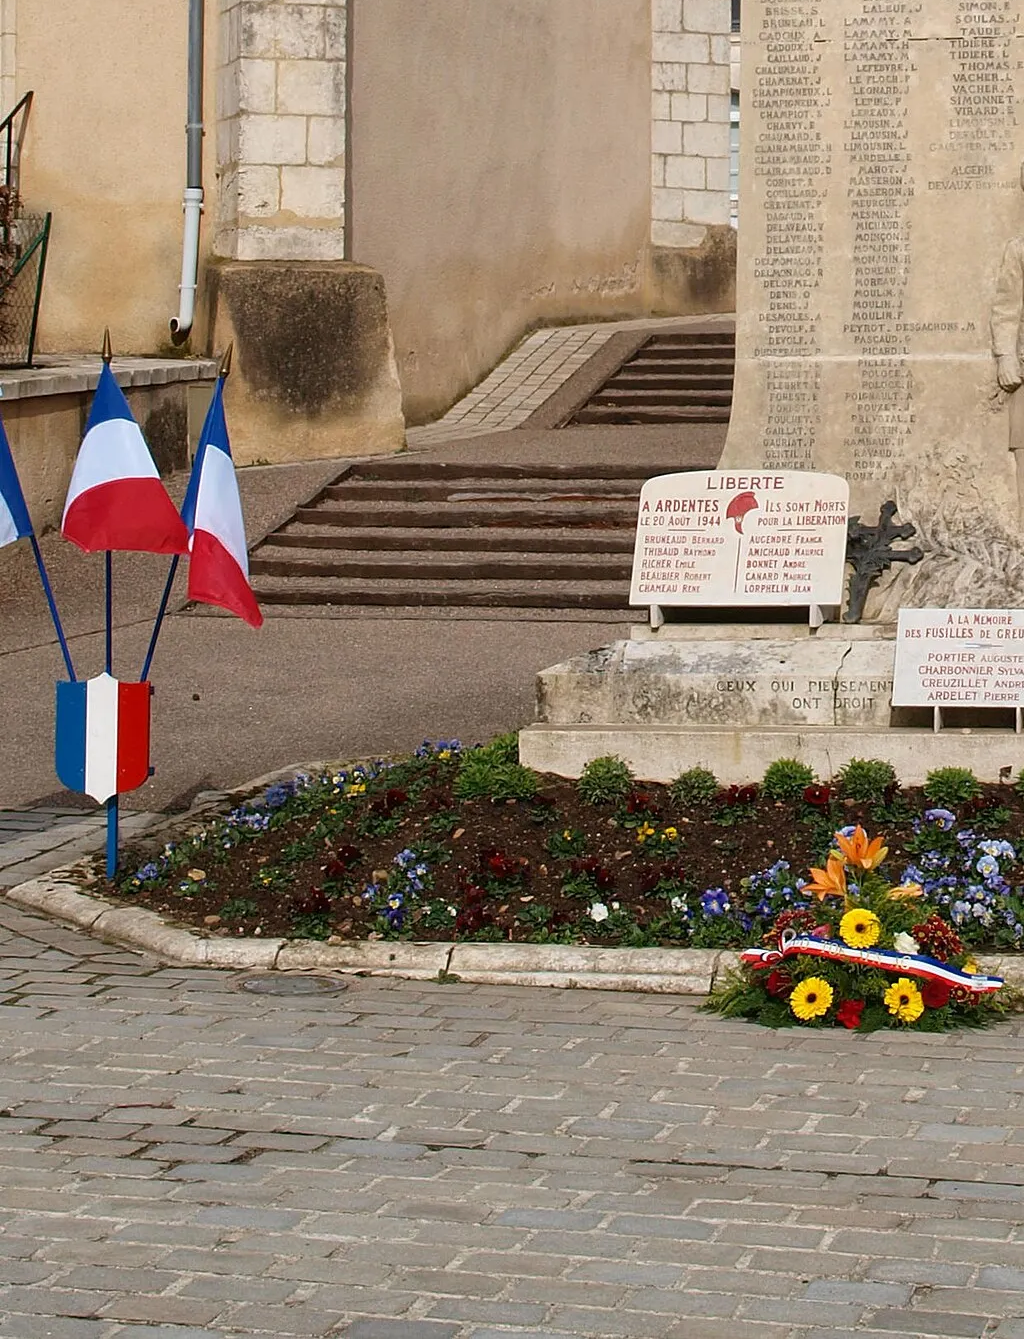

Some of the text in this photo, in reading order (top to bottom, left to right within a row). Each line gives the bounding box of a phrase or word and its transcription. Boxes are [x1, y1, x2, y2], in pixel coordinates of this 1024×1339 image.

[707, 477, 784, 490] LIBERTE
[642, 500, 719, 512] A ARDENTES
[640, 517, 650, 526] LE
[653, 516, 664, 526] 20
[697, 516, 720, 526] 1944
[758, 516, 845, 526] POUR LA LIBERATION
[644, 548, 679, 556] THIBAUD
[947, 614, 953, 624] A
[958, 615, 969, 624] LA
[905, 629, 921, 638] DES
[980, 630, 991, 638] DE
[928, 653, 1024, 663] PORTIER AUGUSTE
[918, 666, 993, 676] CHARBONNIER
[717, 681, 757, 692] CEUX
[771, 681, 795, 692] QUI
[922, 679, 988, 688] CREUZILLET
[928, 691, 1019, 701] ARDELET PIERRE
[792, 697, 822, 709] ONT
[833, 698, 876, 709] DROIT
